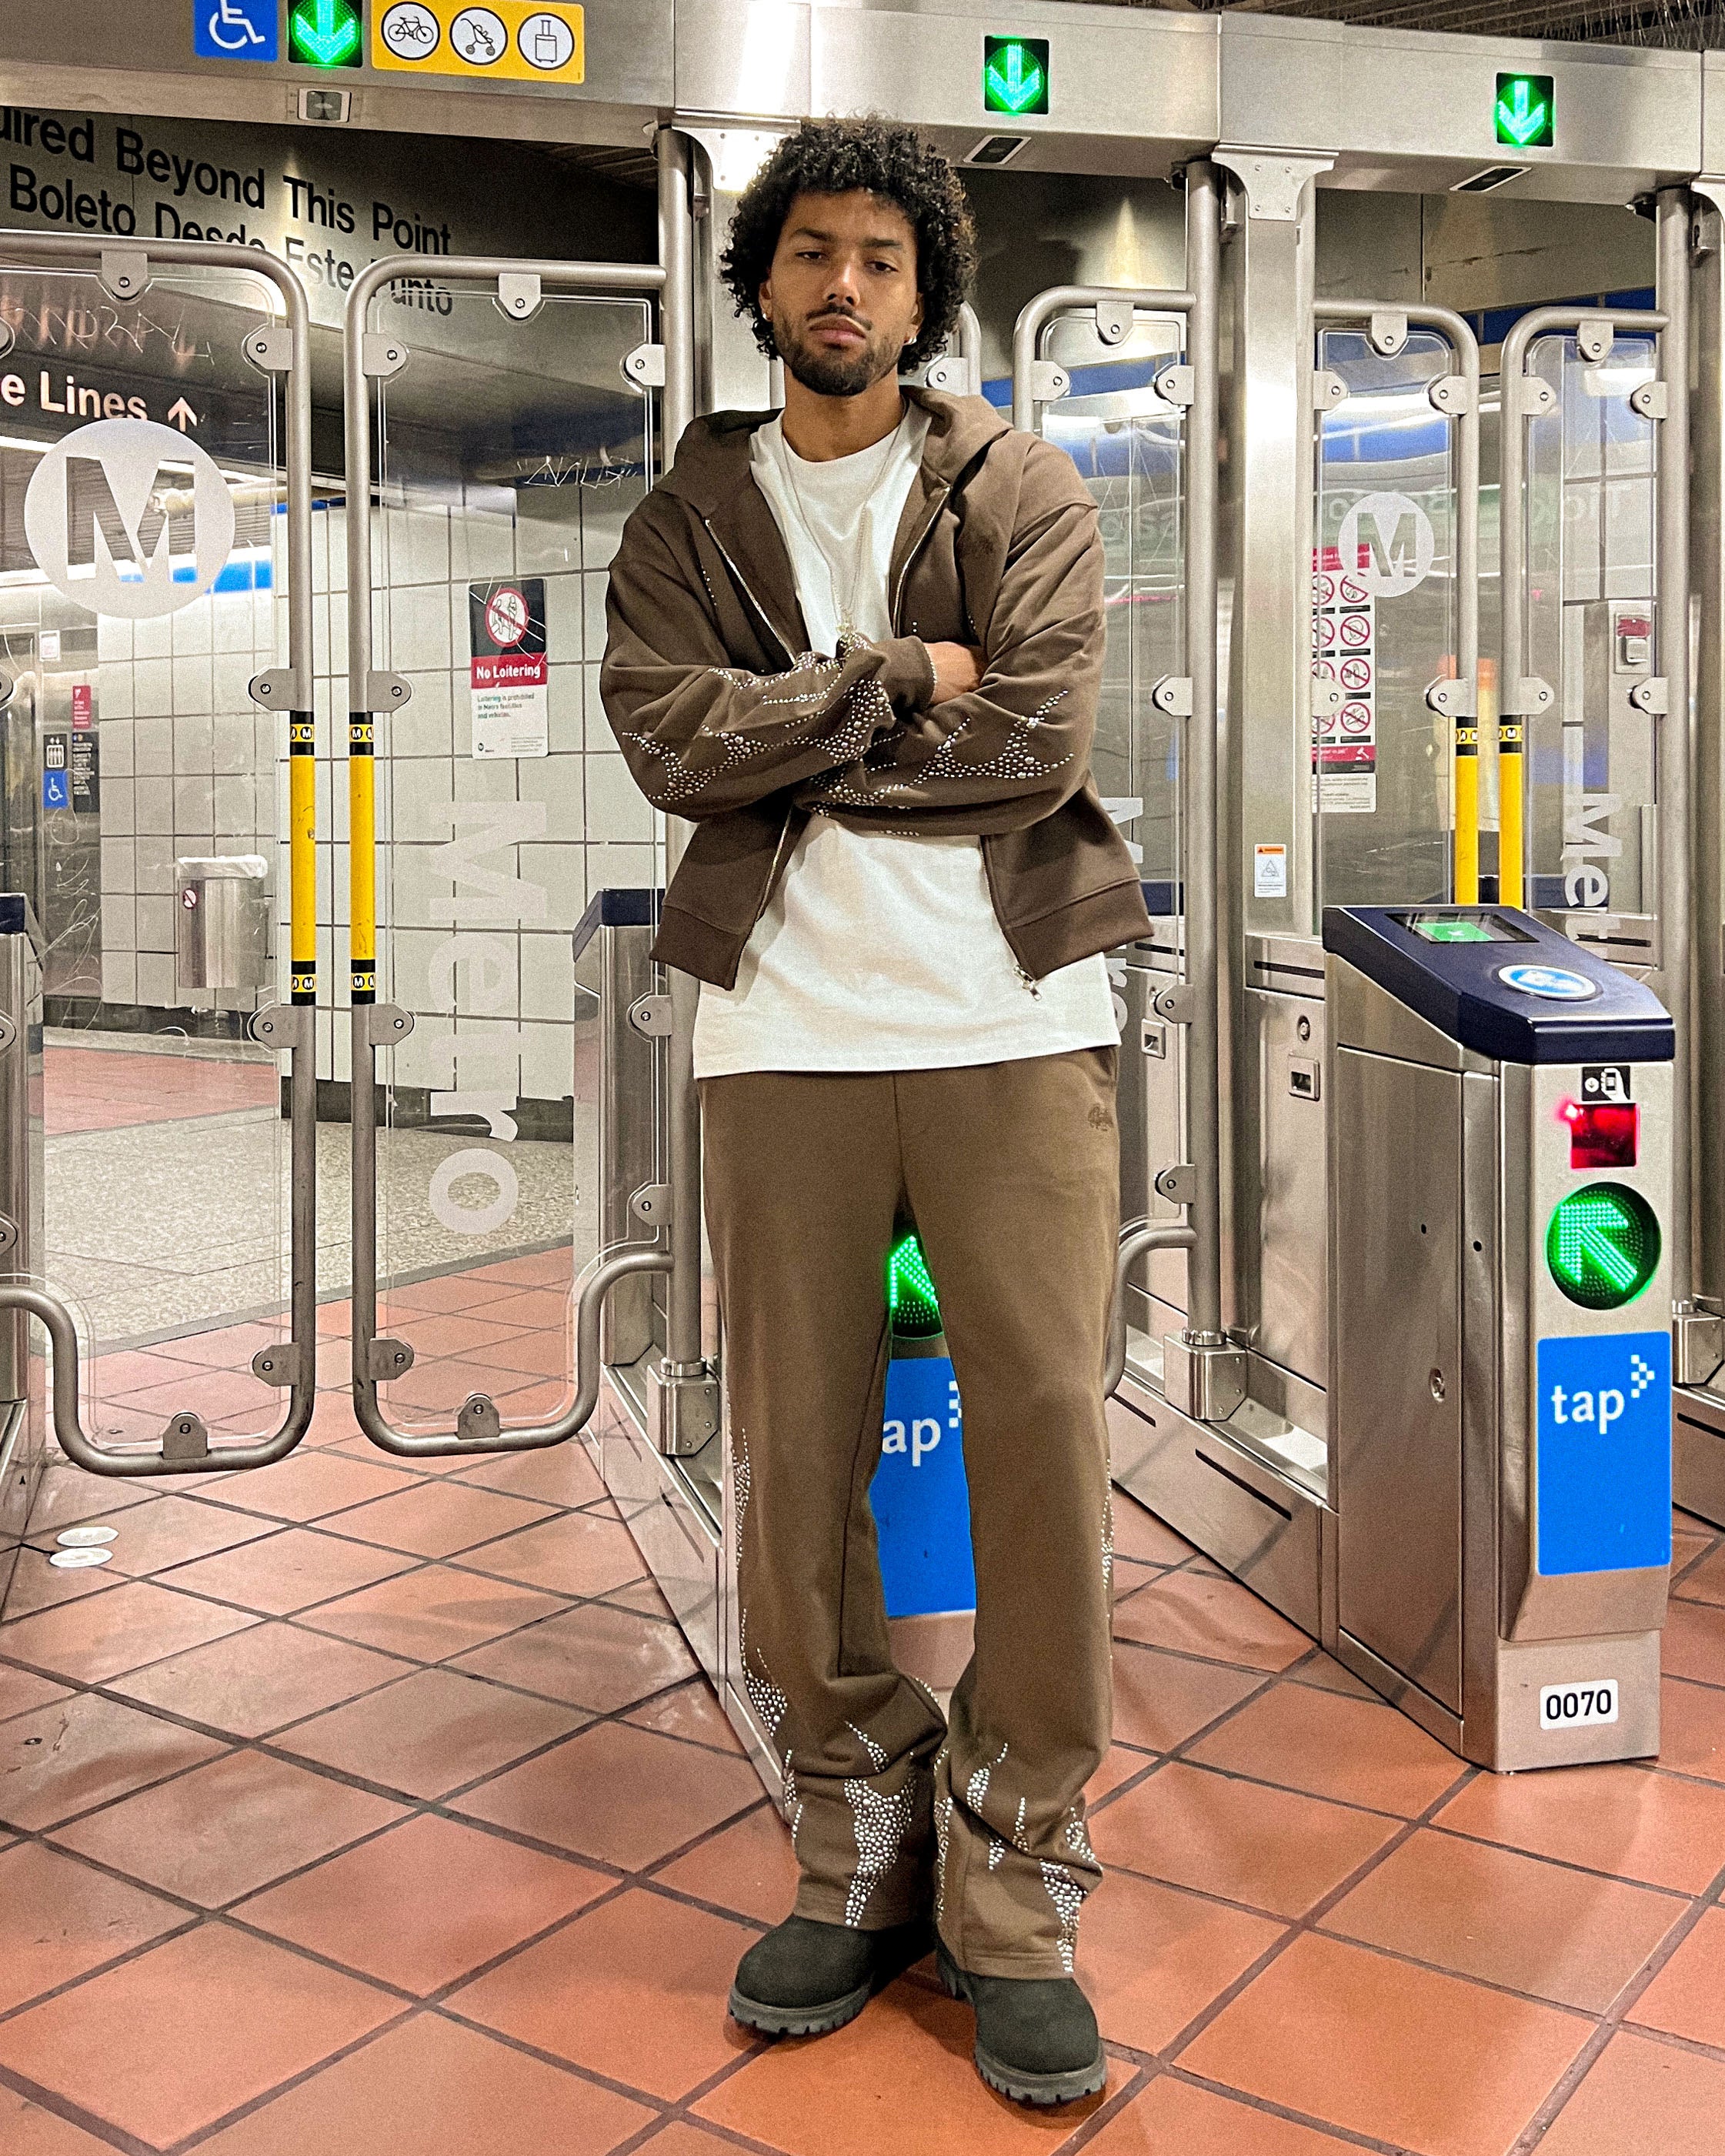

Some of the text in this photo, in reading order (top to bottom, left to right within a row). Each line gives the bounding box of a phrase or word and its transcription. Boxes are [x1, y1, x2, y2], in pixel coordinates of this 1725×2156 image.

[116, 127, 265, 209] Beyond
[282, 175, 355, 234] This
[372, 202, 452, 255] Point
[10, 163, 136, 235] Boleto
[371, 260, 452, 316] unto
[40, 371, 148, 421] Lines
[66, 456, 198, 582] M
[1357, 513, 1416, 577] M
[476, 664, 541, 679] No Loitering
[1564, 793, 1623, 960] Met
[428, 800, 548, 1231] Metro
[882, 1417, 941, 1467] ap
[1551, 1385, 1626, 1435] tap
[1546, 1688, 1613, 1721] 0070
